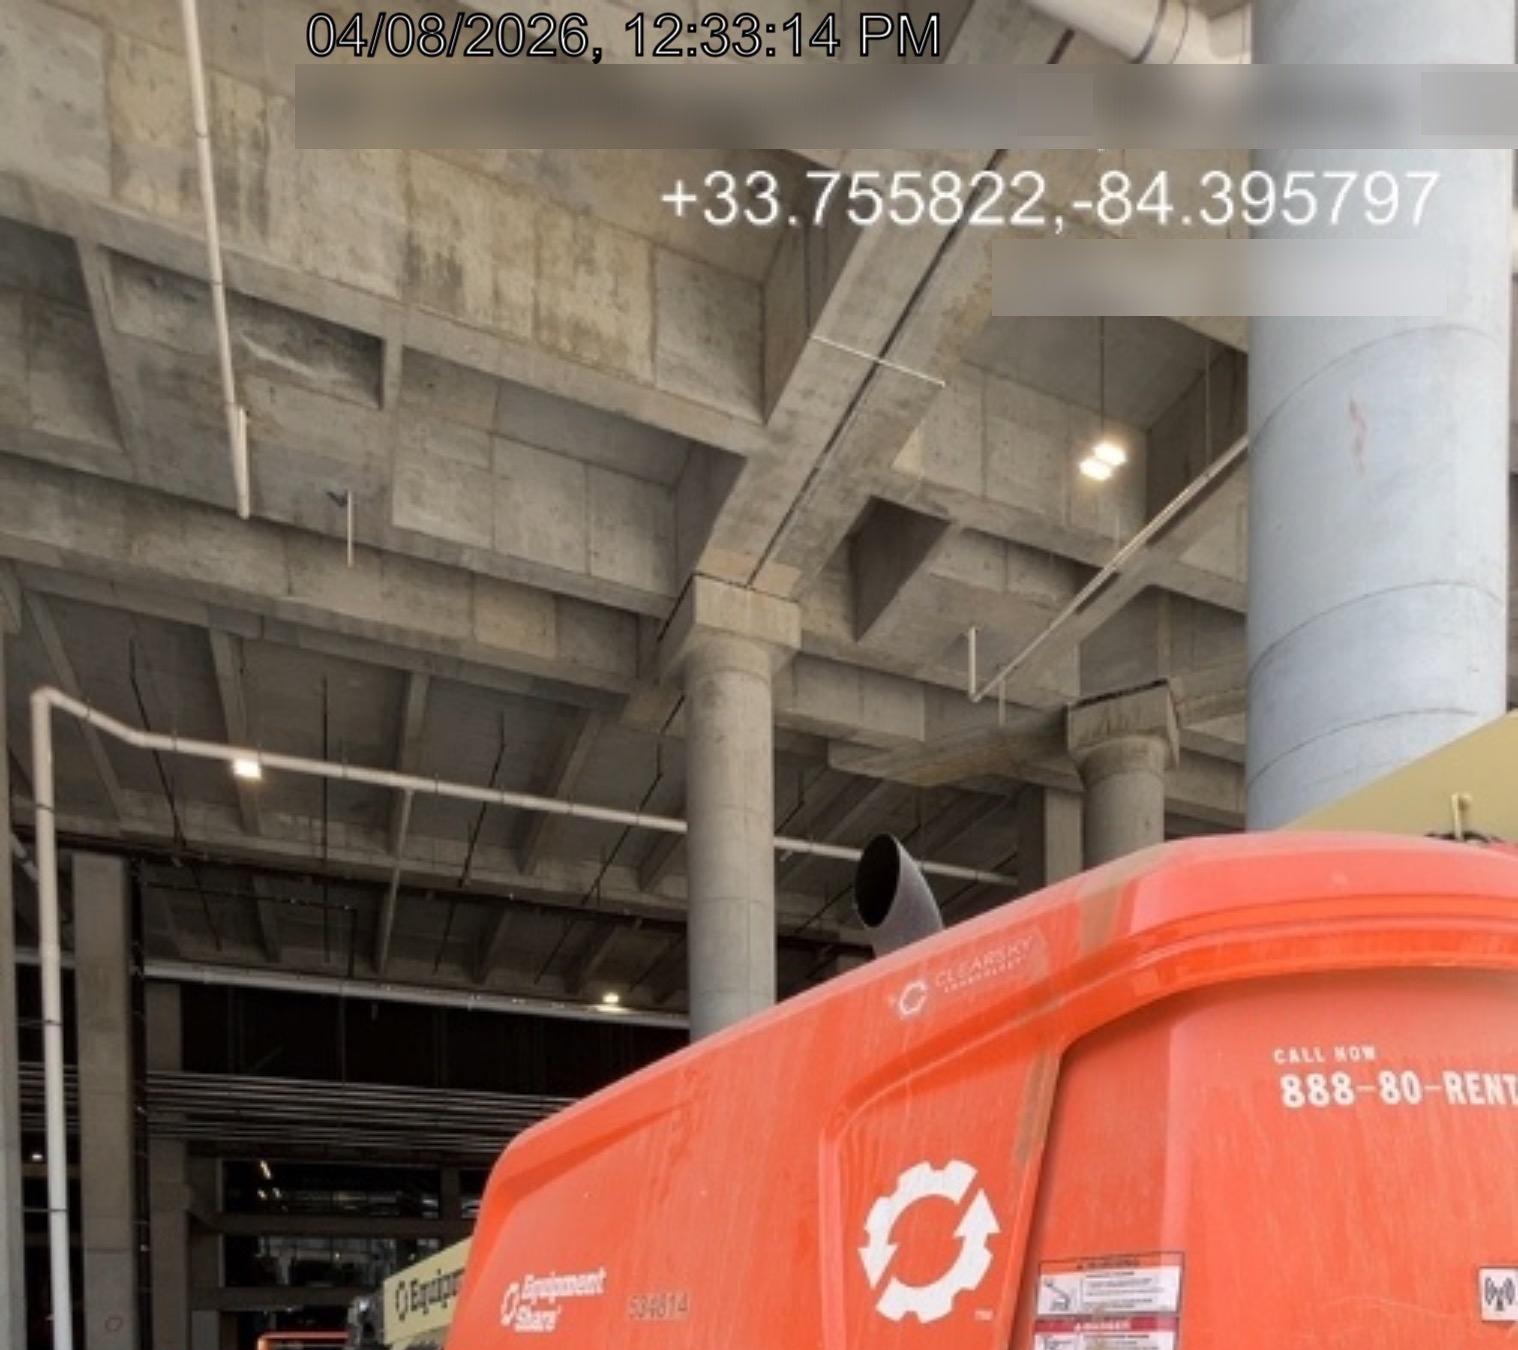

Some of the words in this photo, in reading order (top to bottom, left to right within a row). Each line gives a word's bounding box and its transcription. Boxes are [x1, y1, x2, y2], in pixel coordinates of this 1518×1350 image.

[1273, 1047, 1325, 1064] CALL
[1334, 1045, 1376, 1062] NOW
[1280, 1069, 1518, 1109] 888-80-RENT
[521, 1267, 607, 1305] Equipment
[514, 1305, 557, 1333] Share
